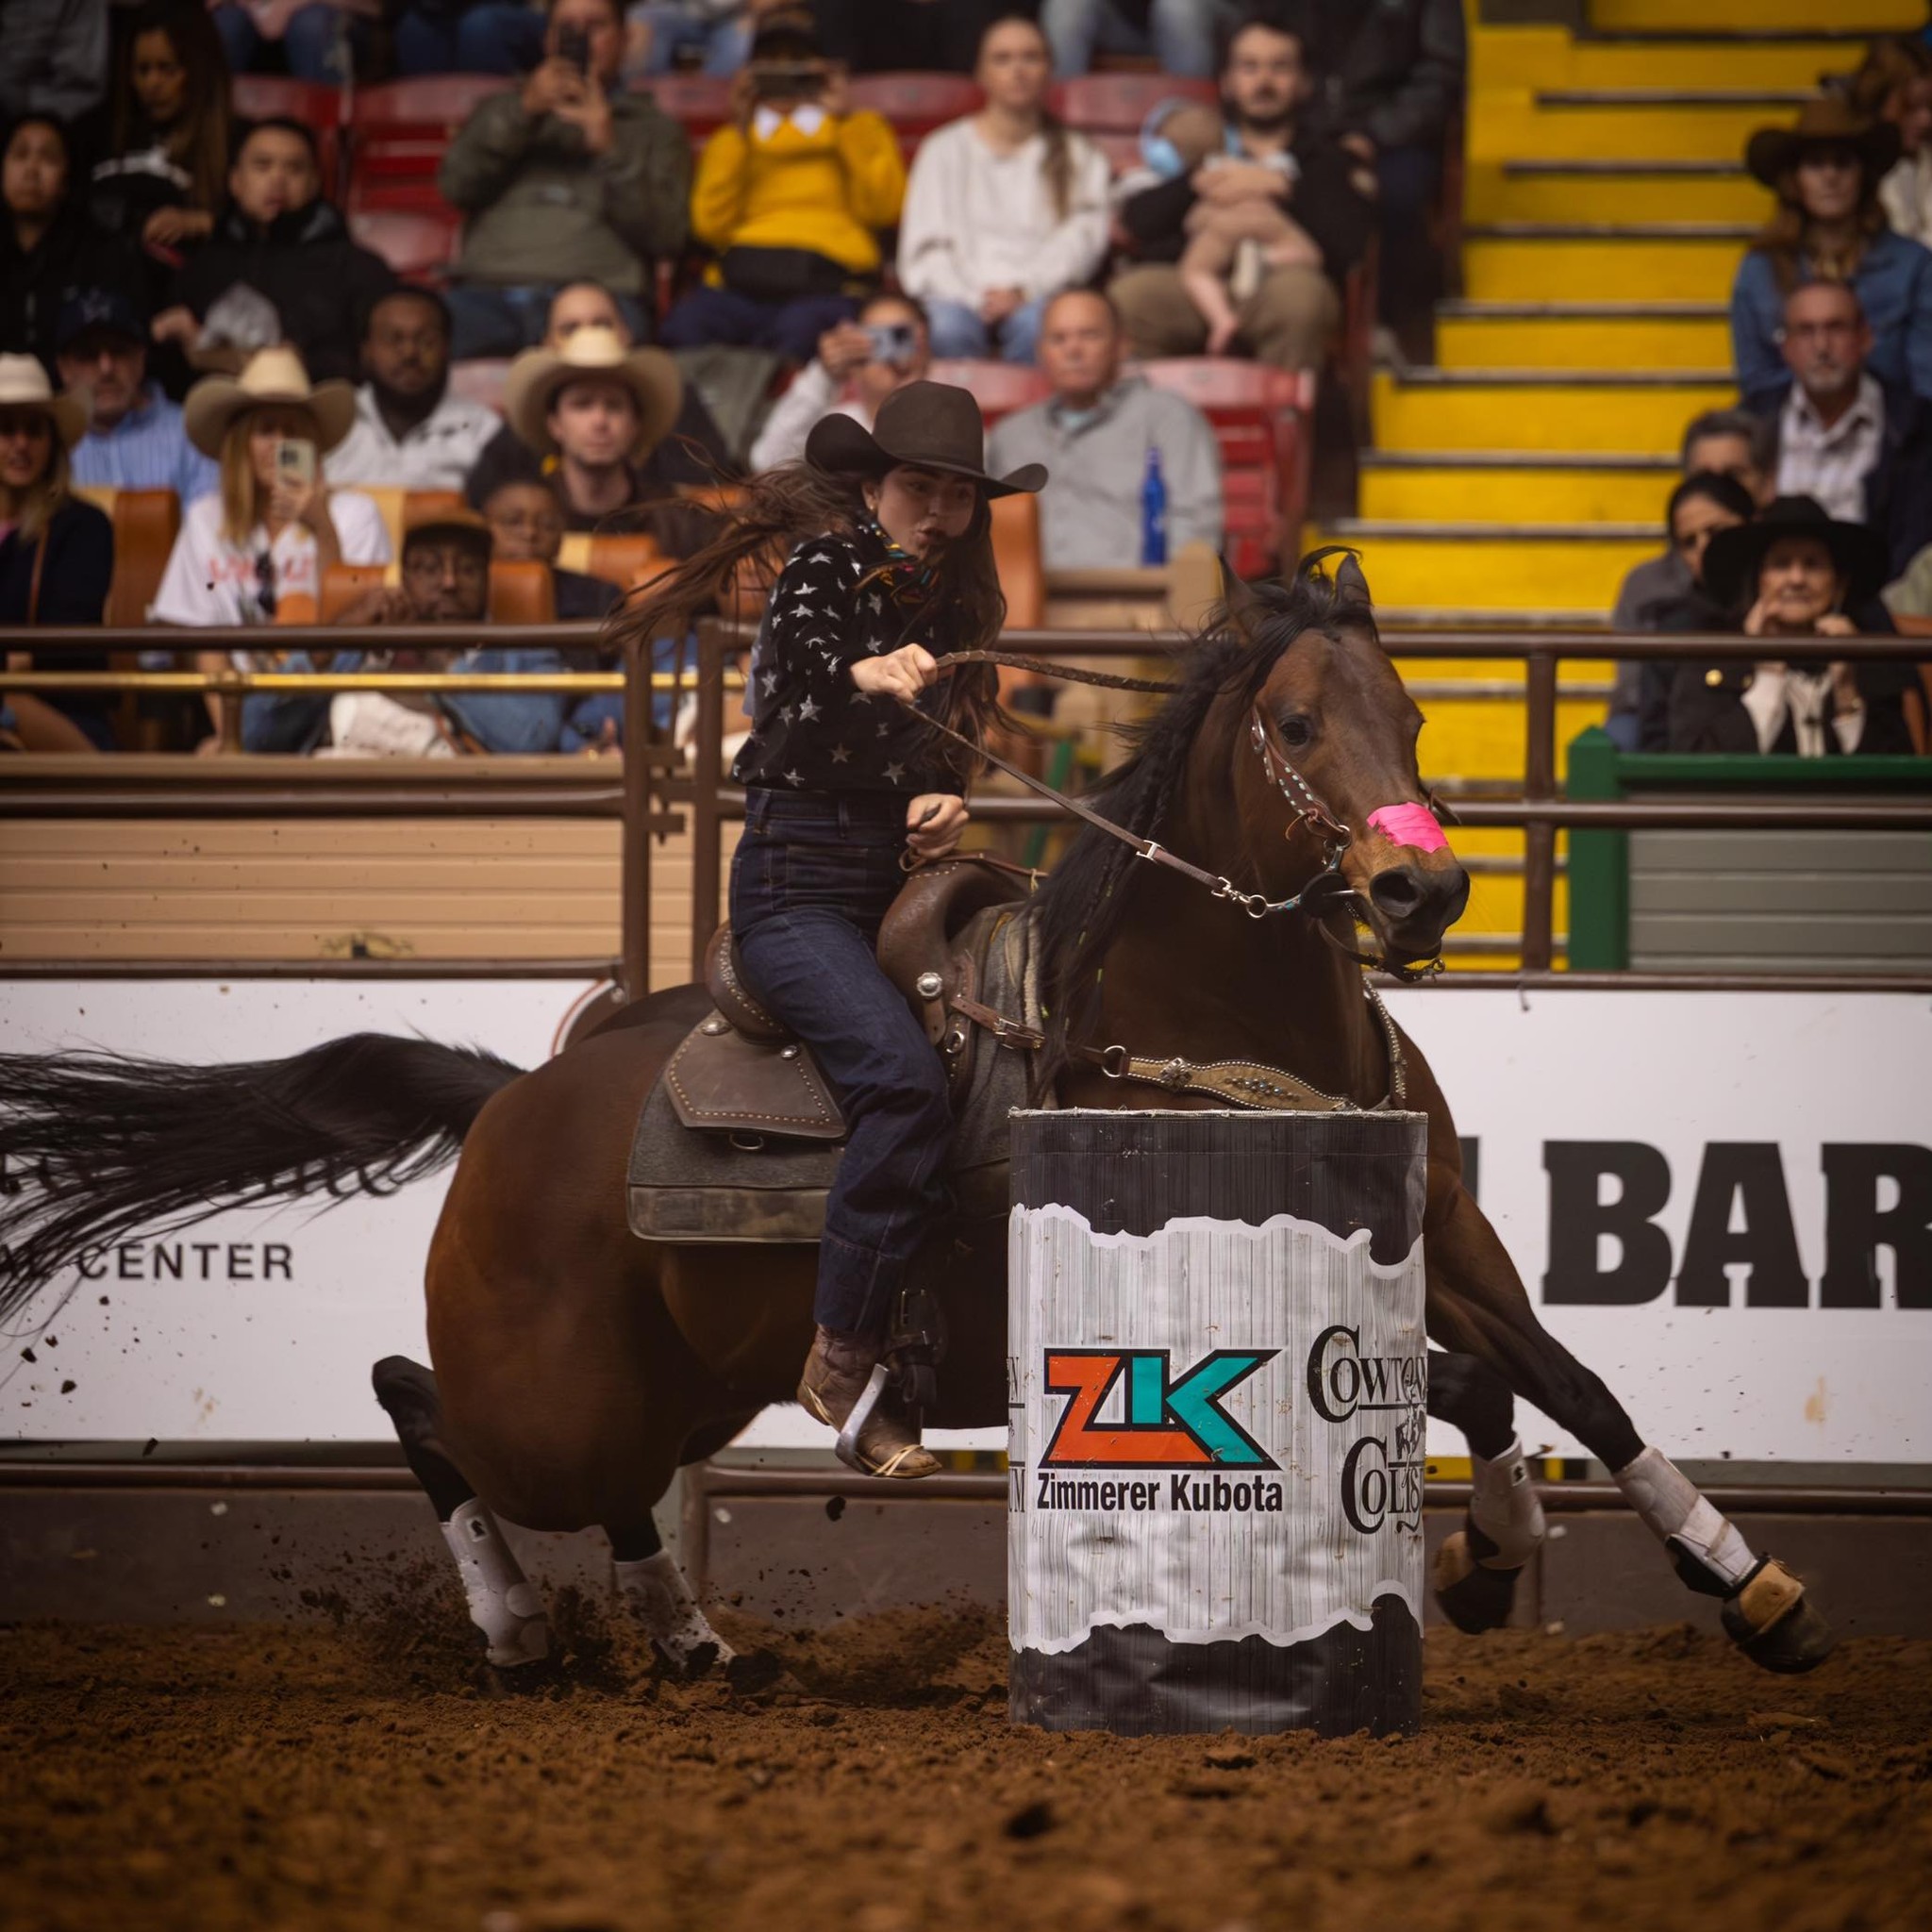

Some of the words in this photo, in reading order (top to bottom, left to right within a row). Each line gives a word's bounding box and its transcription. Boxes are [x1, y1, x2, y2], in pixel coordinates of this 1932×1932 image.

[77, 1243, 293, 1280] CENTER
[1038, 1473, 1160, 1510] Zimmerer
[1171, 1474, 1283, 1511] Kubota
[1341, 1437, 1424, 1534] COLIS
